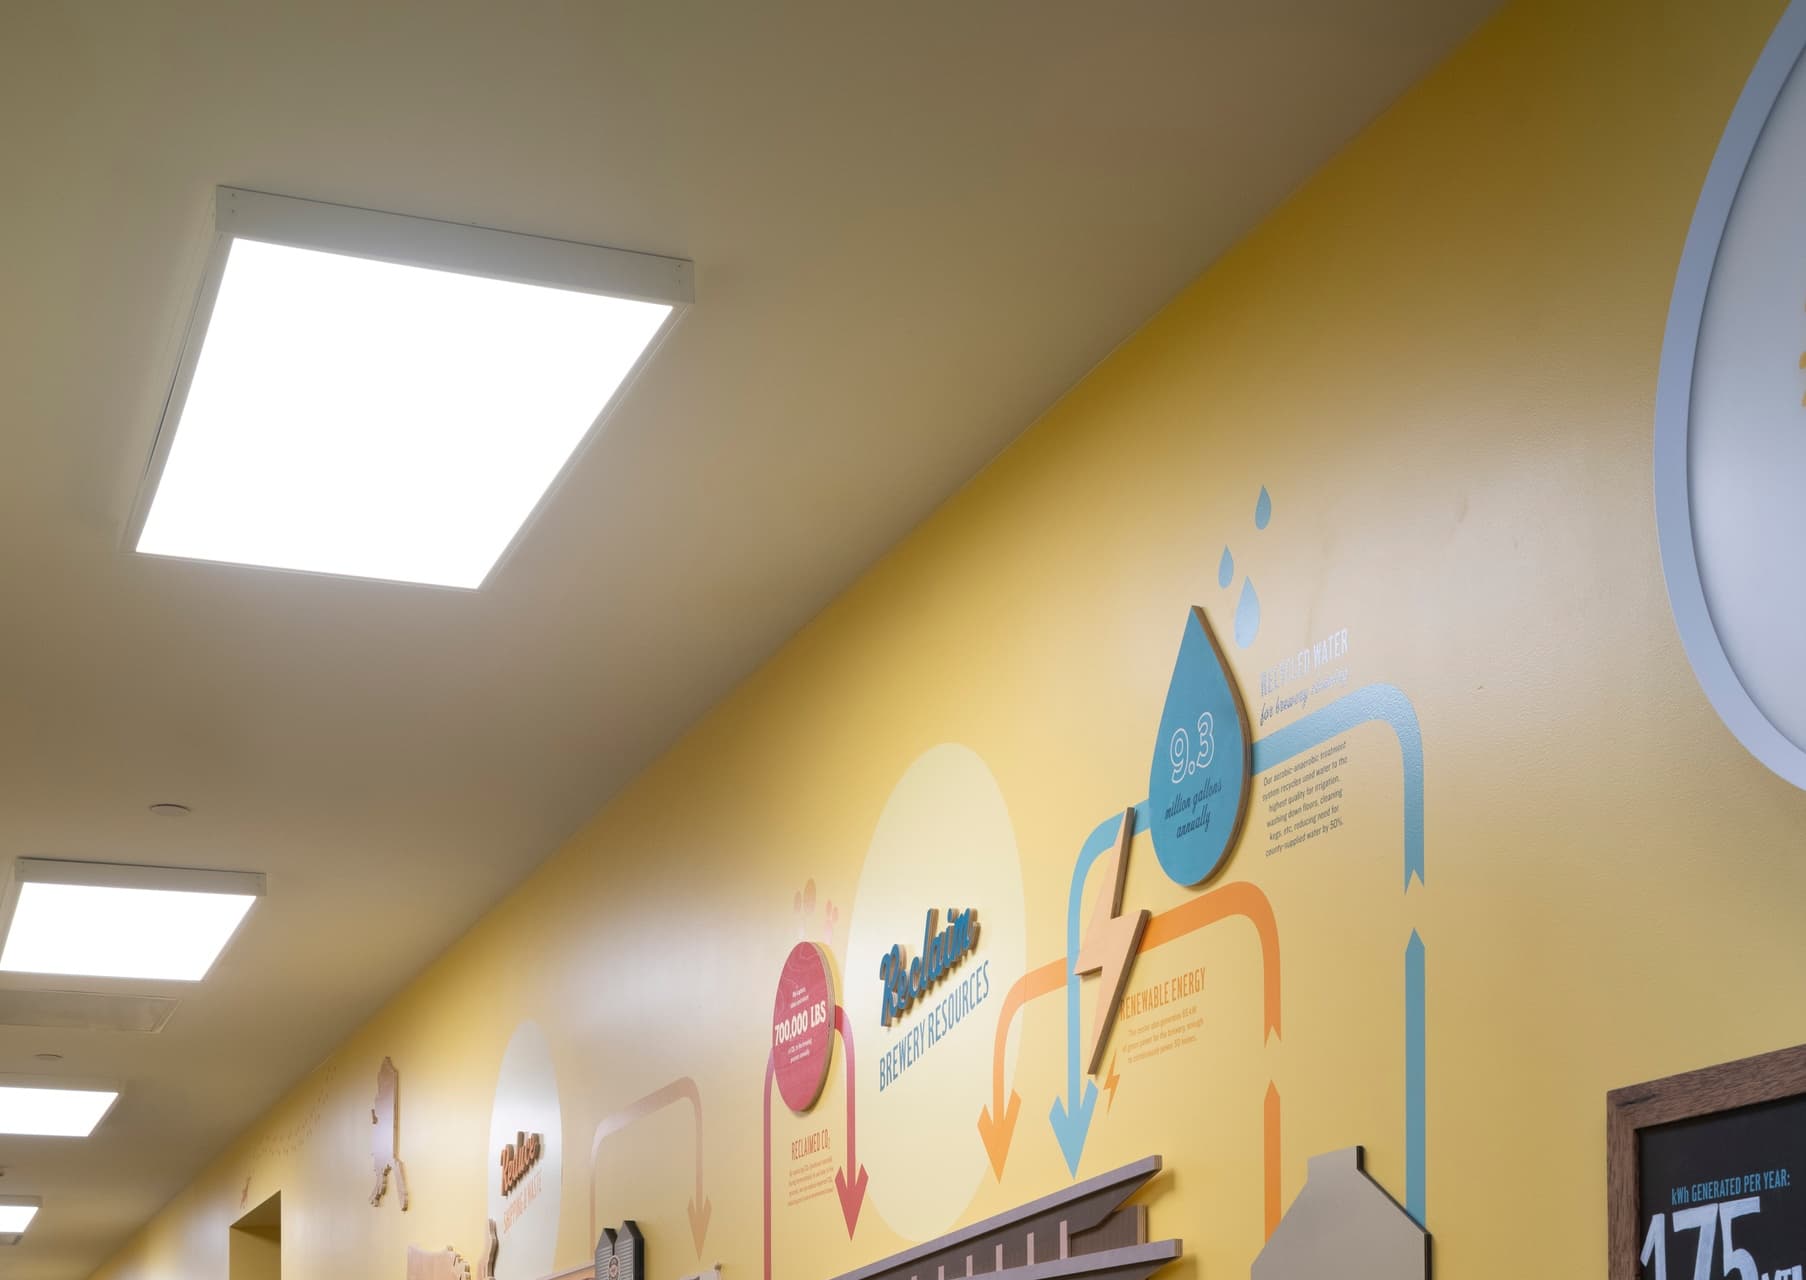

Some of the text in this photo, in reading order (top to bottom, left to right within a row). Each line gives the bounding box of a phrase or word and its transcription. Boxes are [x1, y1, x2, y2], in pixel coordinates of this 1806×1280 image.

[1313, 627, 1347, 668] WATER
[1170, 711, 1214, 784] 9.3
[1165, 776, 1222, 820] million gallons
[1176, 803, 1211, 839] annually
[880, 908, 978, 1027] Reclaim
[810, 1000, 826, 1028] LBS
[1120, 967, 1205, 1022] RENEWABLE ENERGY
[880, 960, 989, 1092] BREWERY RESOURCES
[792, 1131, 819, 1160] RECLAIMED
[1671, 1168, 1790, 1206] kWh GENERATED PER YEAR:
